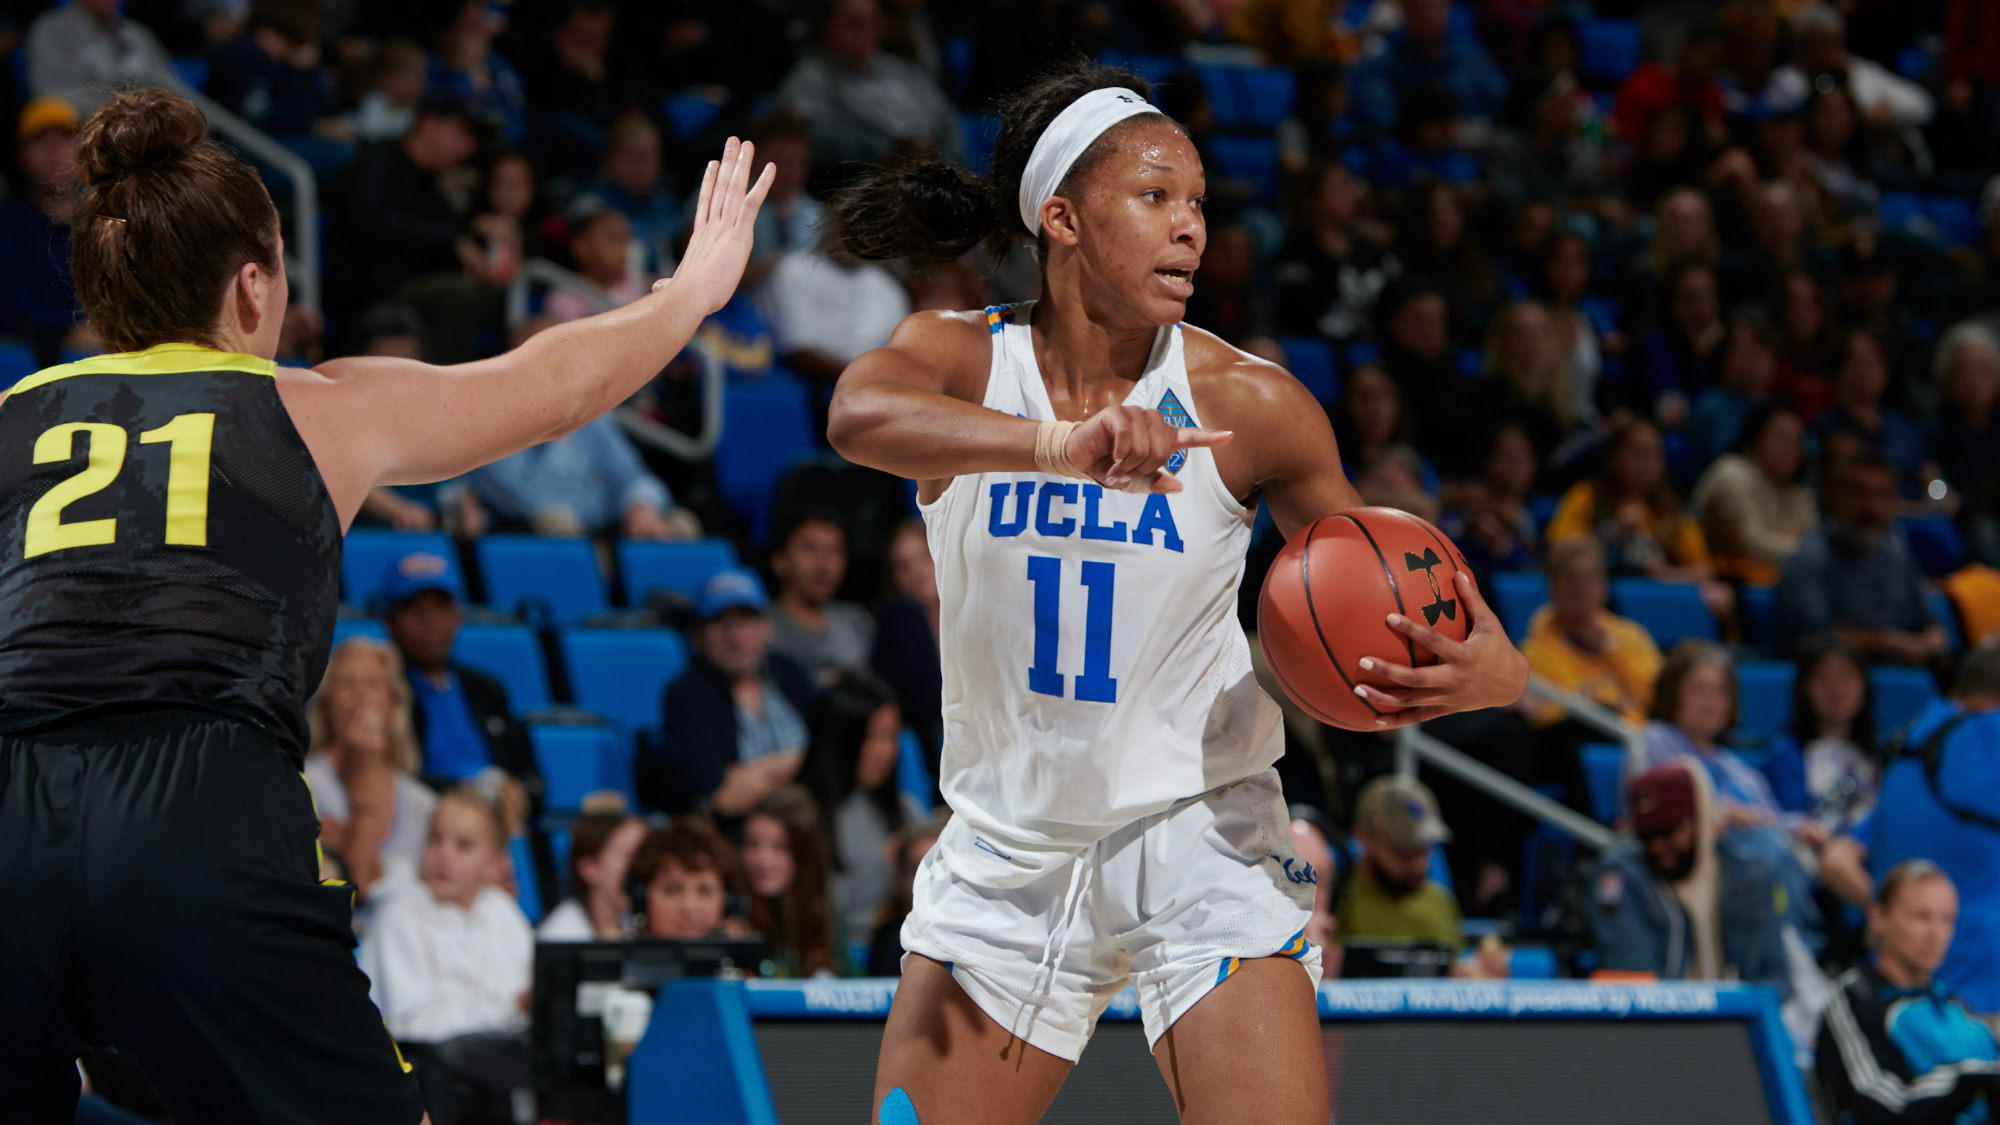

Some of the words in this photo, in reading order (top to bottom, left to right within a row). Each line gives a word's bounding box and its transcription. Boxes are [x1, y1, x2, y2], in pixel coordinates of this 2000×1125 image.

[24, 412, 216, 560] 21
[988, 480, 1184, 553] UCLA
[1027, 555, 1117, 703] 11
